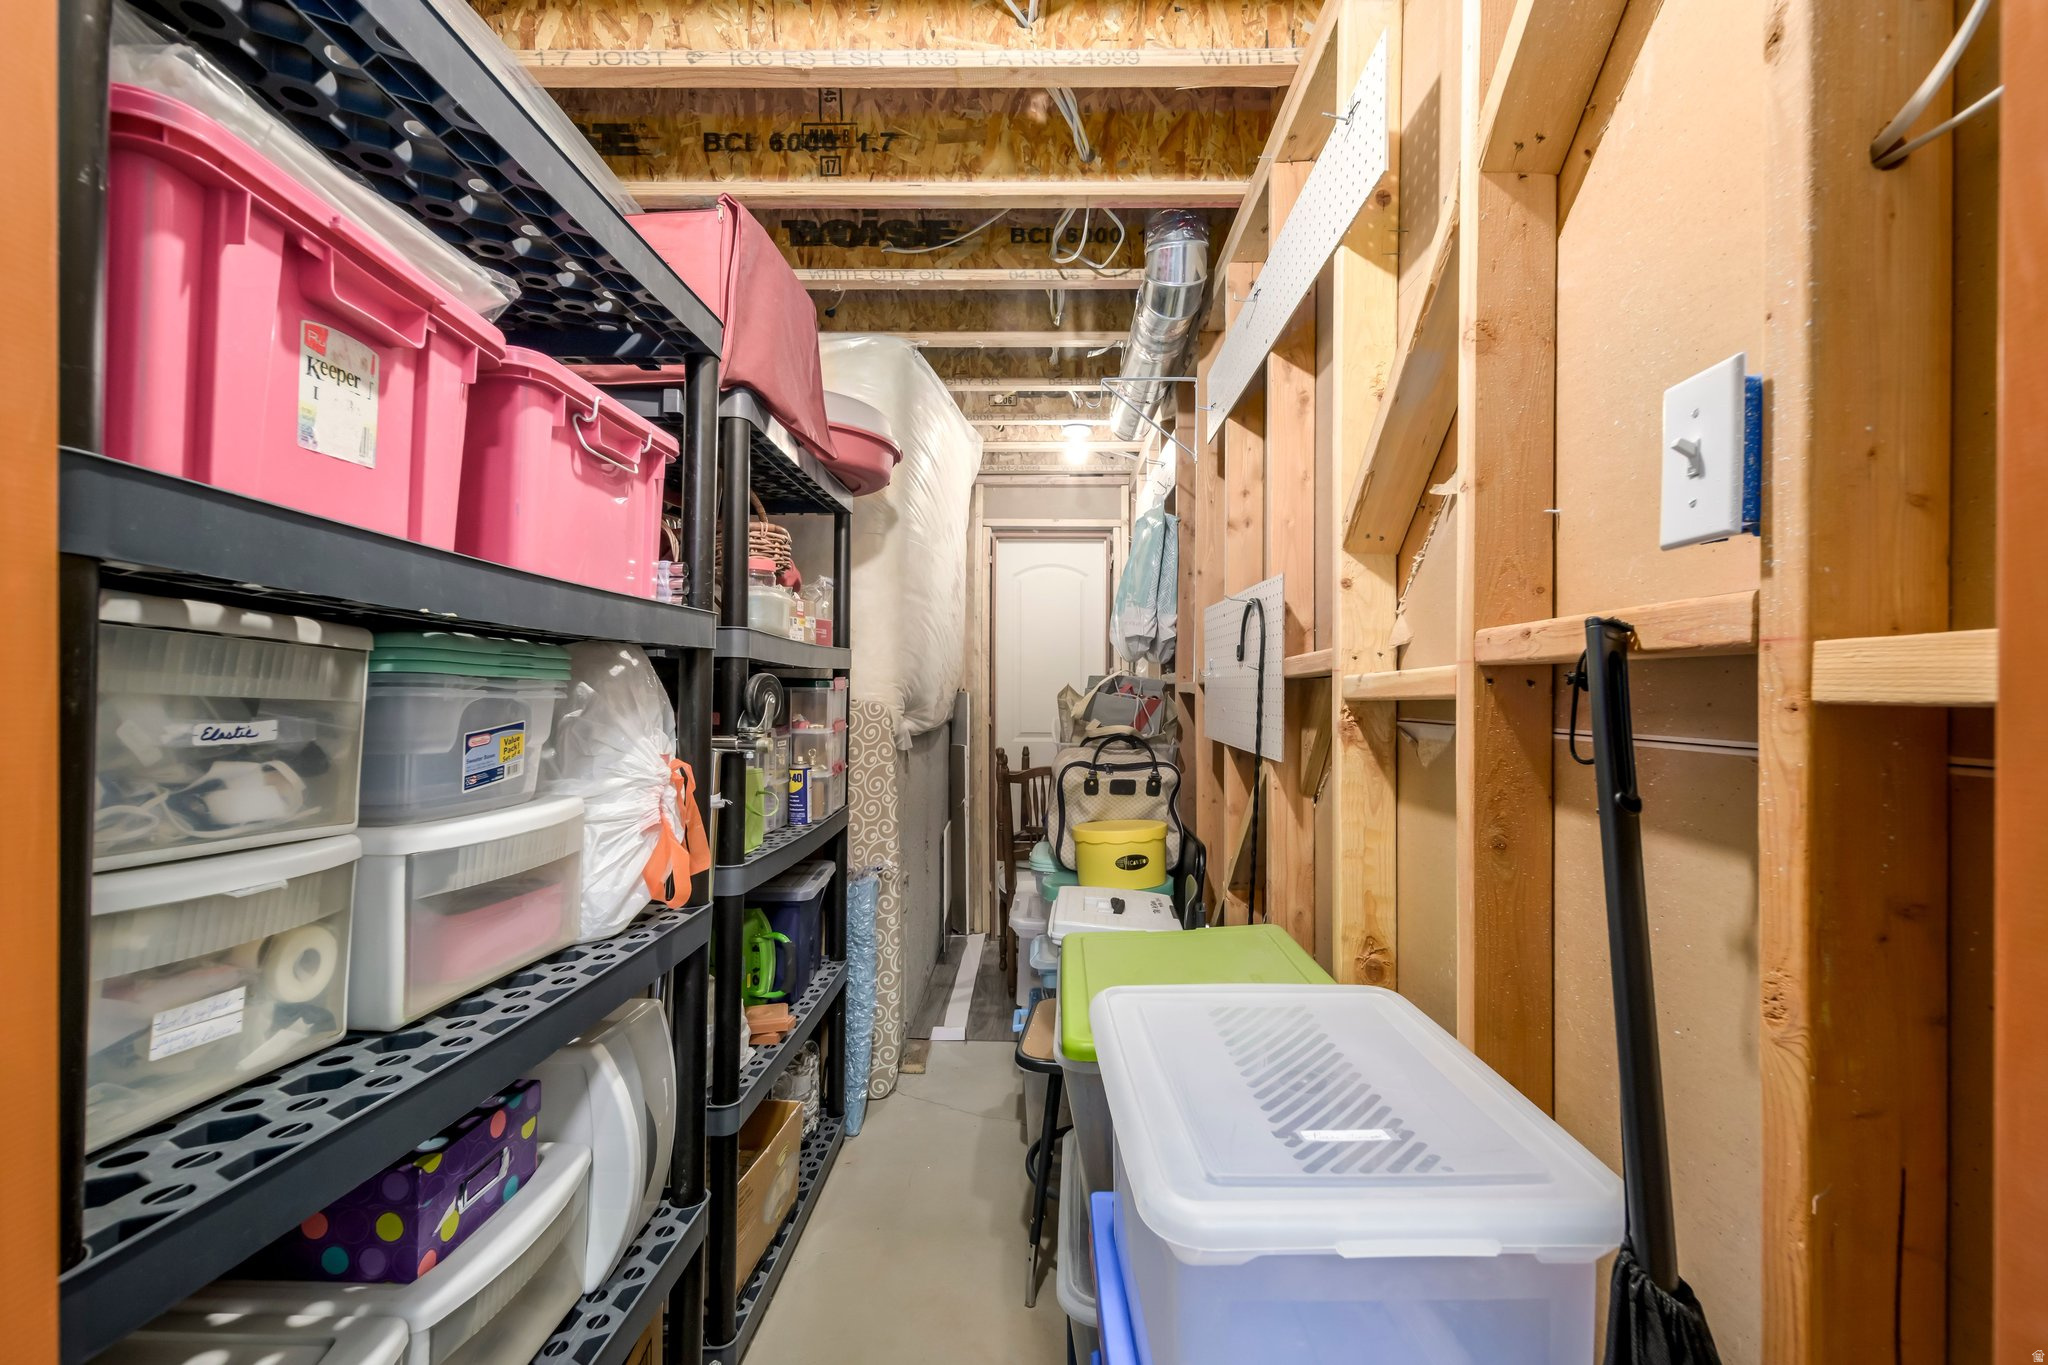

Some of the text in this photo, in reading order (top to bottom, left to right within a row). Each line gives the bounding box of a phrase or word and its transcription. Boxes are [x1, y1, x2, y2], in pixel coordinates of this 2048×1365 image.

[534, 51, 570, 66] 1.7
[588, 51, 667, 66] JOIST
[729, 50, 774, 66] ICC
[783, 50, 816, 66] ES
[832, 50, 885, 66] ESR
[904, 50, 959, 66] 1336
[1067, 50, 1141, 66] 24999
[1200, 50, 1285, 64] WHITE
[856, 132, 896, 152] 1.7
[825, 160, 837, 174] 17
[1010, 227, 1050, 244] BCI
[808, 270, 864, 281] WHITE
[919, 270, 945, 281] OR
[306, 355, 362, 389] Keeper
[200, 725, 259, 741] Elastic
[503, 736, 521, 746] Value
[503, 742, 520, 755] Pack!
